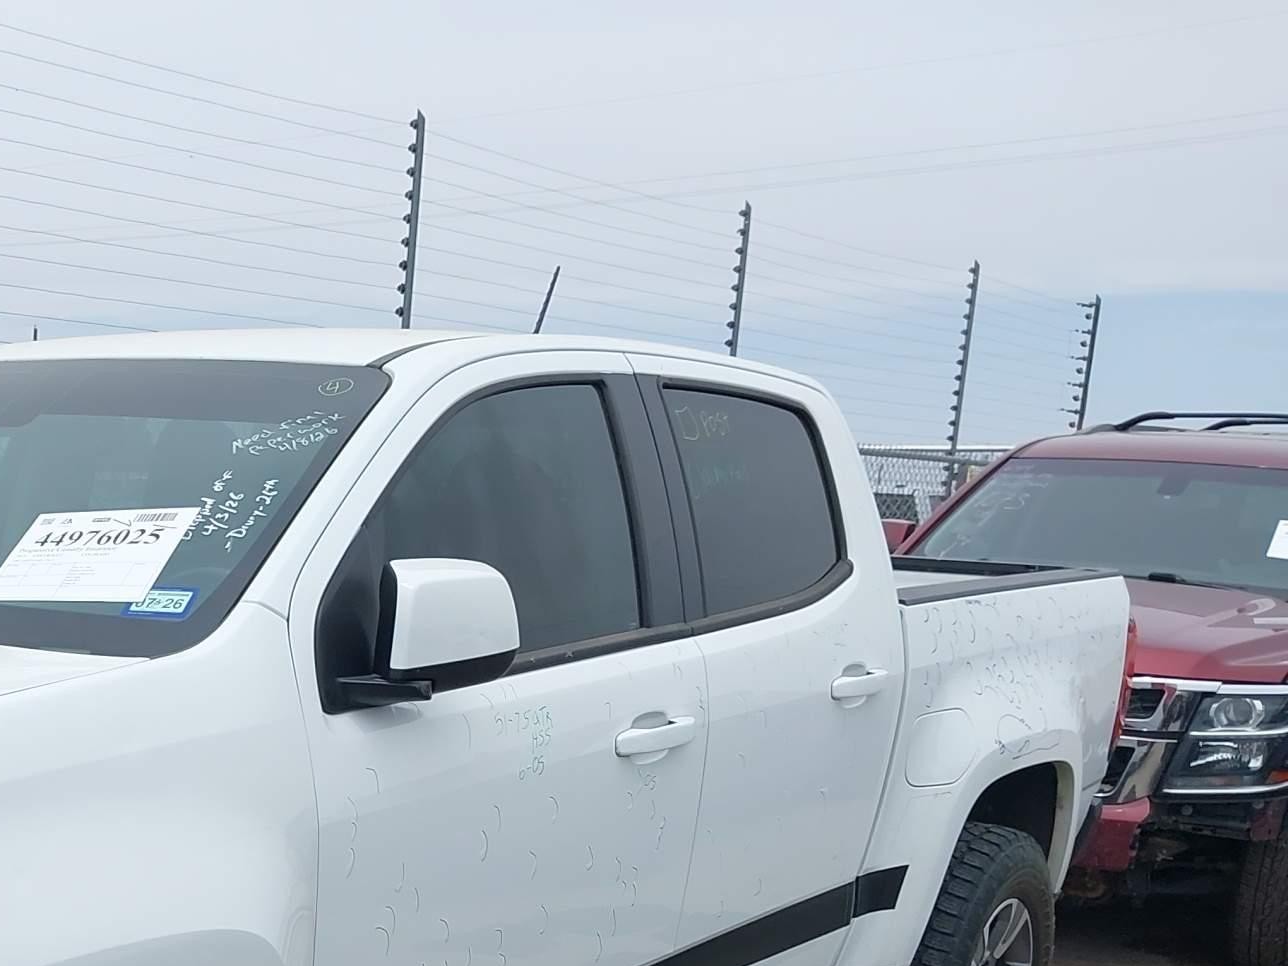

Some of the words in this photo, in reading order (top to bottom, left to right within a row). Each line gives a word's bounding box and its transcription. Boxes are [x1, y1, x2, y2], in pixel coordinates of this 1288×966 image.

[201, 492, 245, 537] 4/3/26
[34, 528, 166, 548] 44976025
[161, 598, 185, 609] 26
